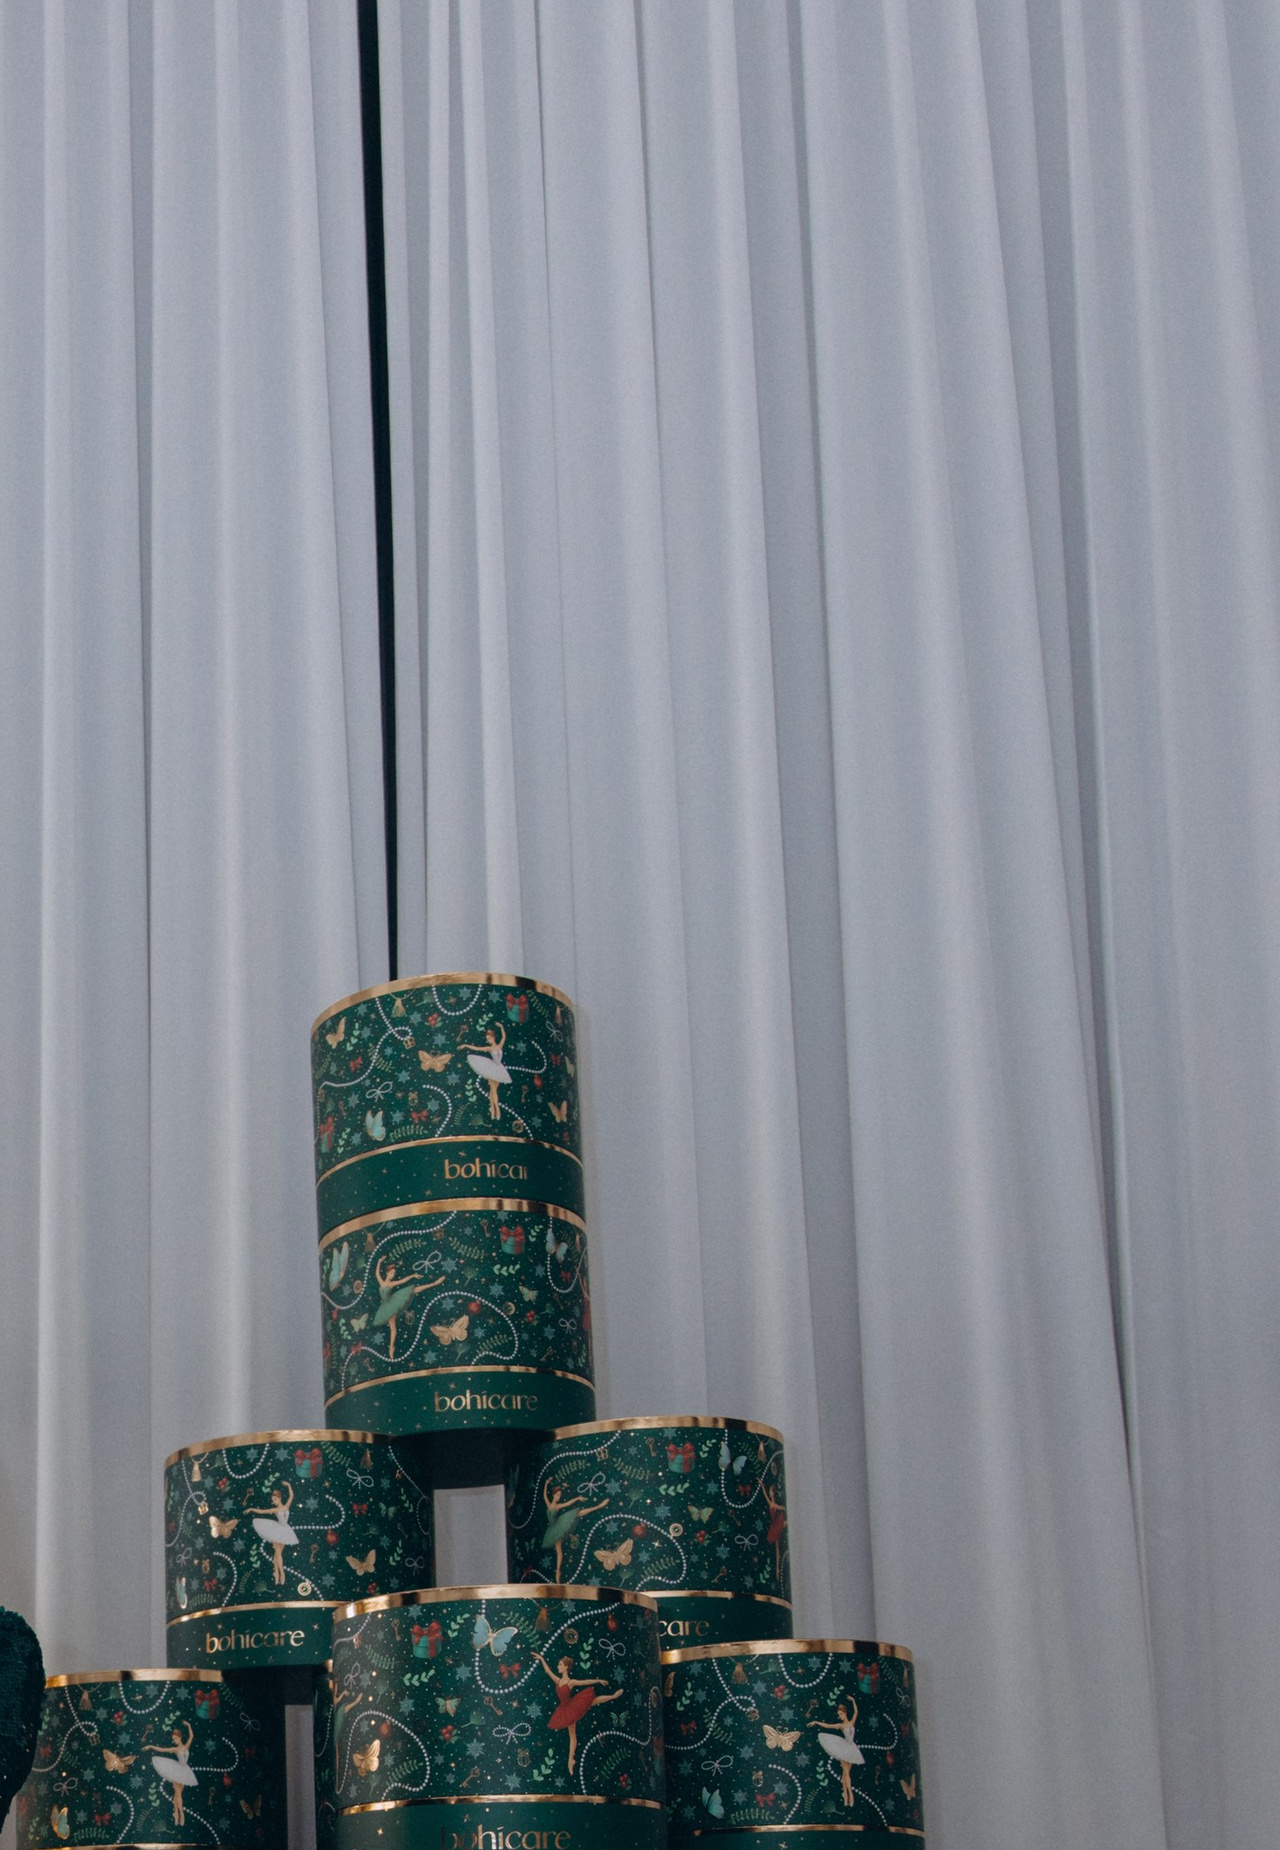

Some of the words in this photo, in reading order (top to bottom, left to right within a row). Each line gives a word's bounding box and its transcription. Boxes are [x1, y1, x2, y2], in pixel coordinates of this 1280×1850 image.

[434, 1389, 538, 1412] bohicare
[205, 1629, 306, 1654] bohicare
[441, 1824, 572, 1850] bohicare
